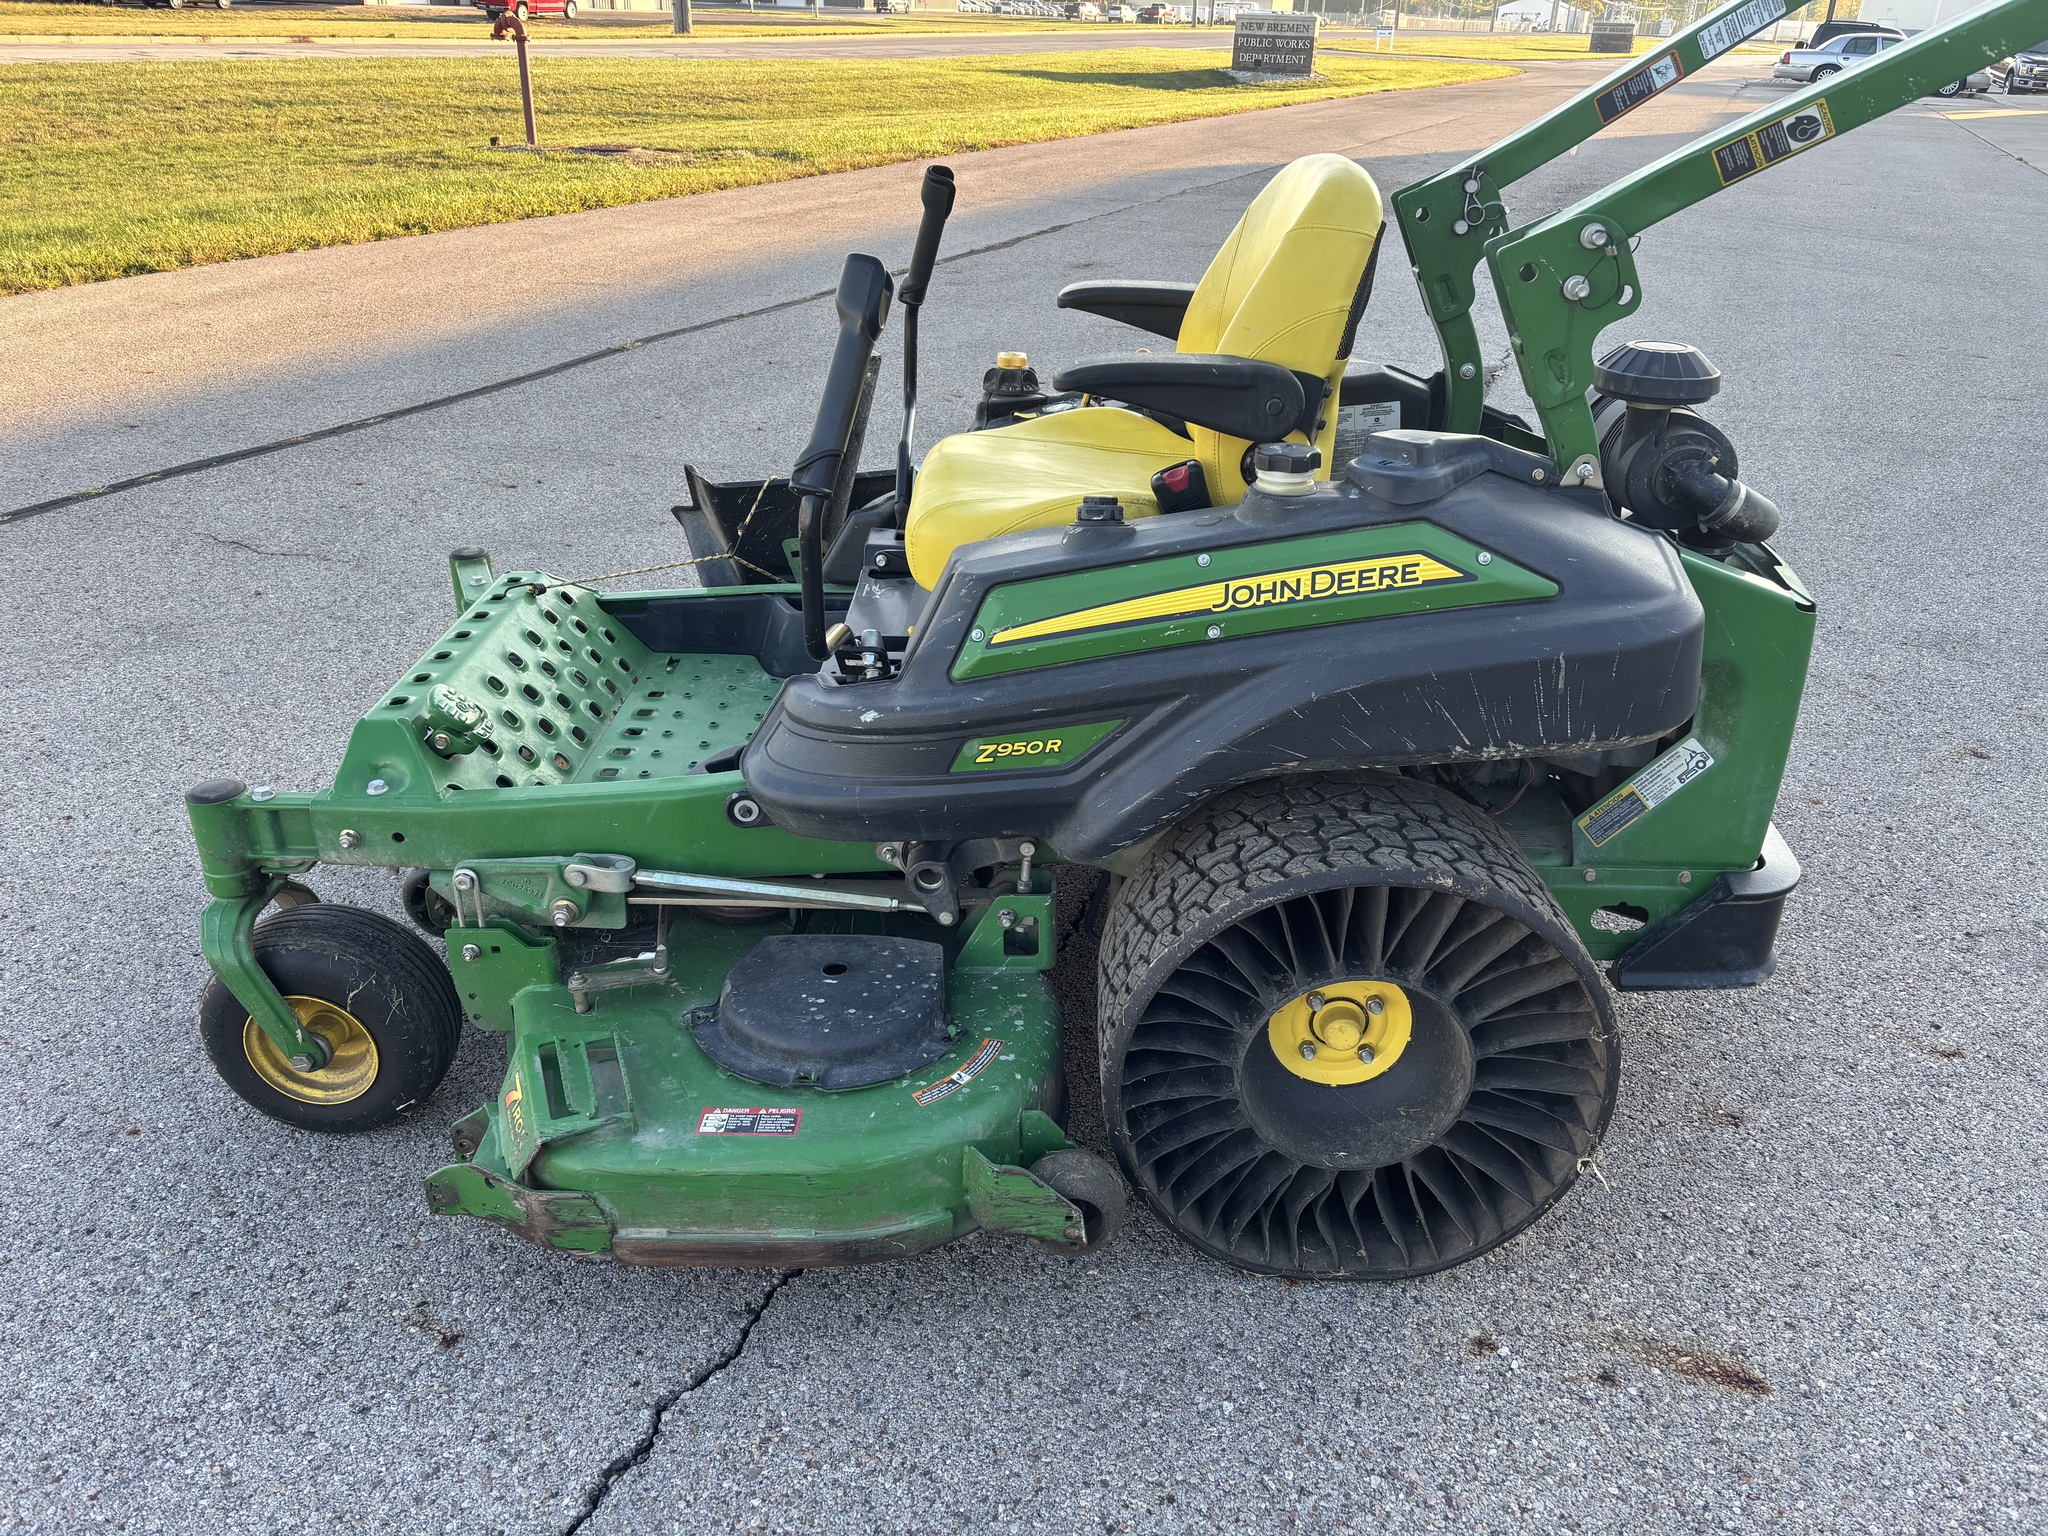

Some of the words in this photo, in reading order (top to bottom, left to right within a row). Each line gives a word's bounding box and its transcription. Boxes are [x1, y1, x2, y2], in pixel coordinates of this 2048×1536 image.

[1241, 22, 1264, 31] NEW
[1267, 23, 1310, 33] BREMEN
[1238, 37, 1272, 48] PUBLIC
[1275, 39, 1311, 49] WORKS
[1239, 53, 1306, 64] DEPARTMENT
[1820, 107, 1833, 134] CAUTION
[1212, 578, 1301, 609] JOHN
[1311, 563, 1420, 595] DEERE
[975, 739, 1062, 763] Z950R
